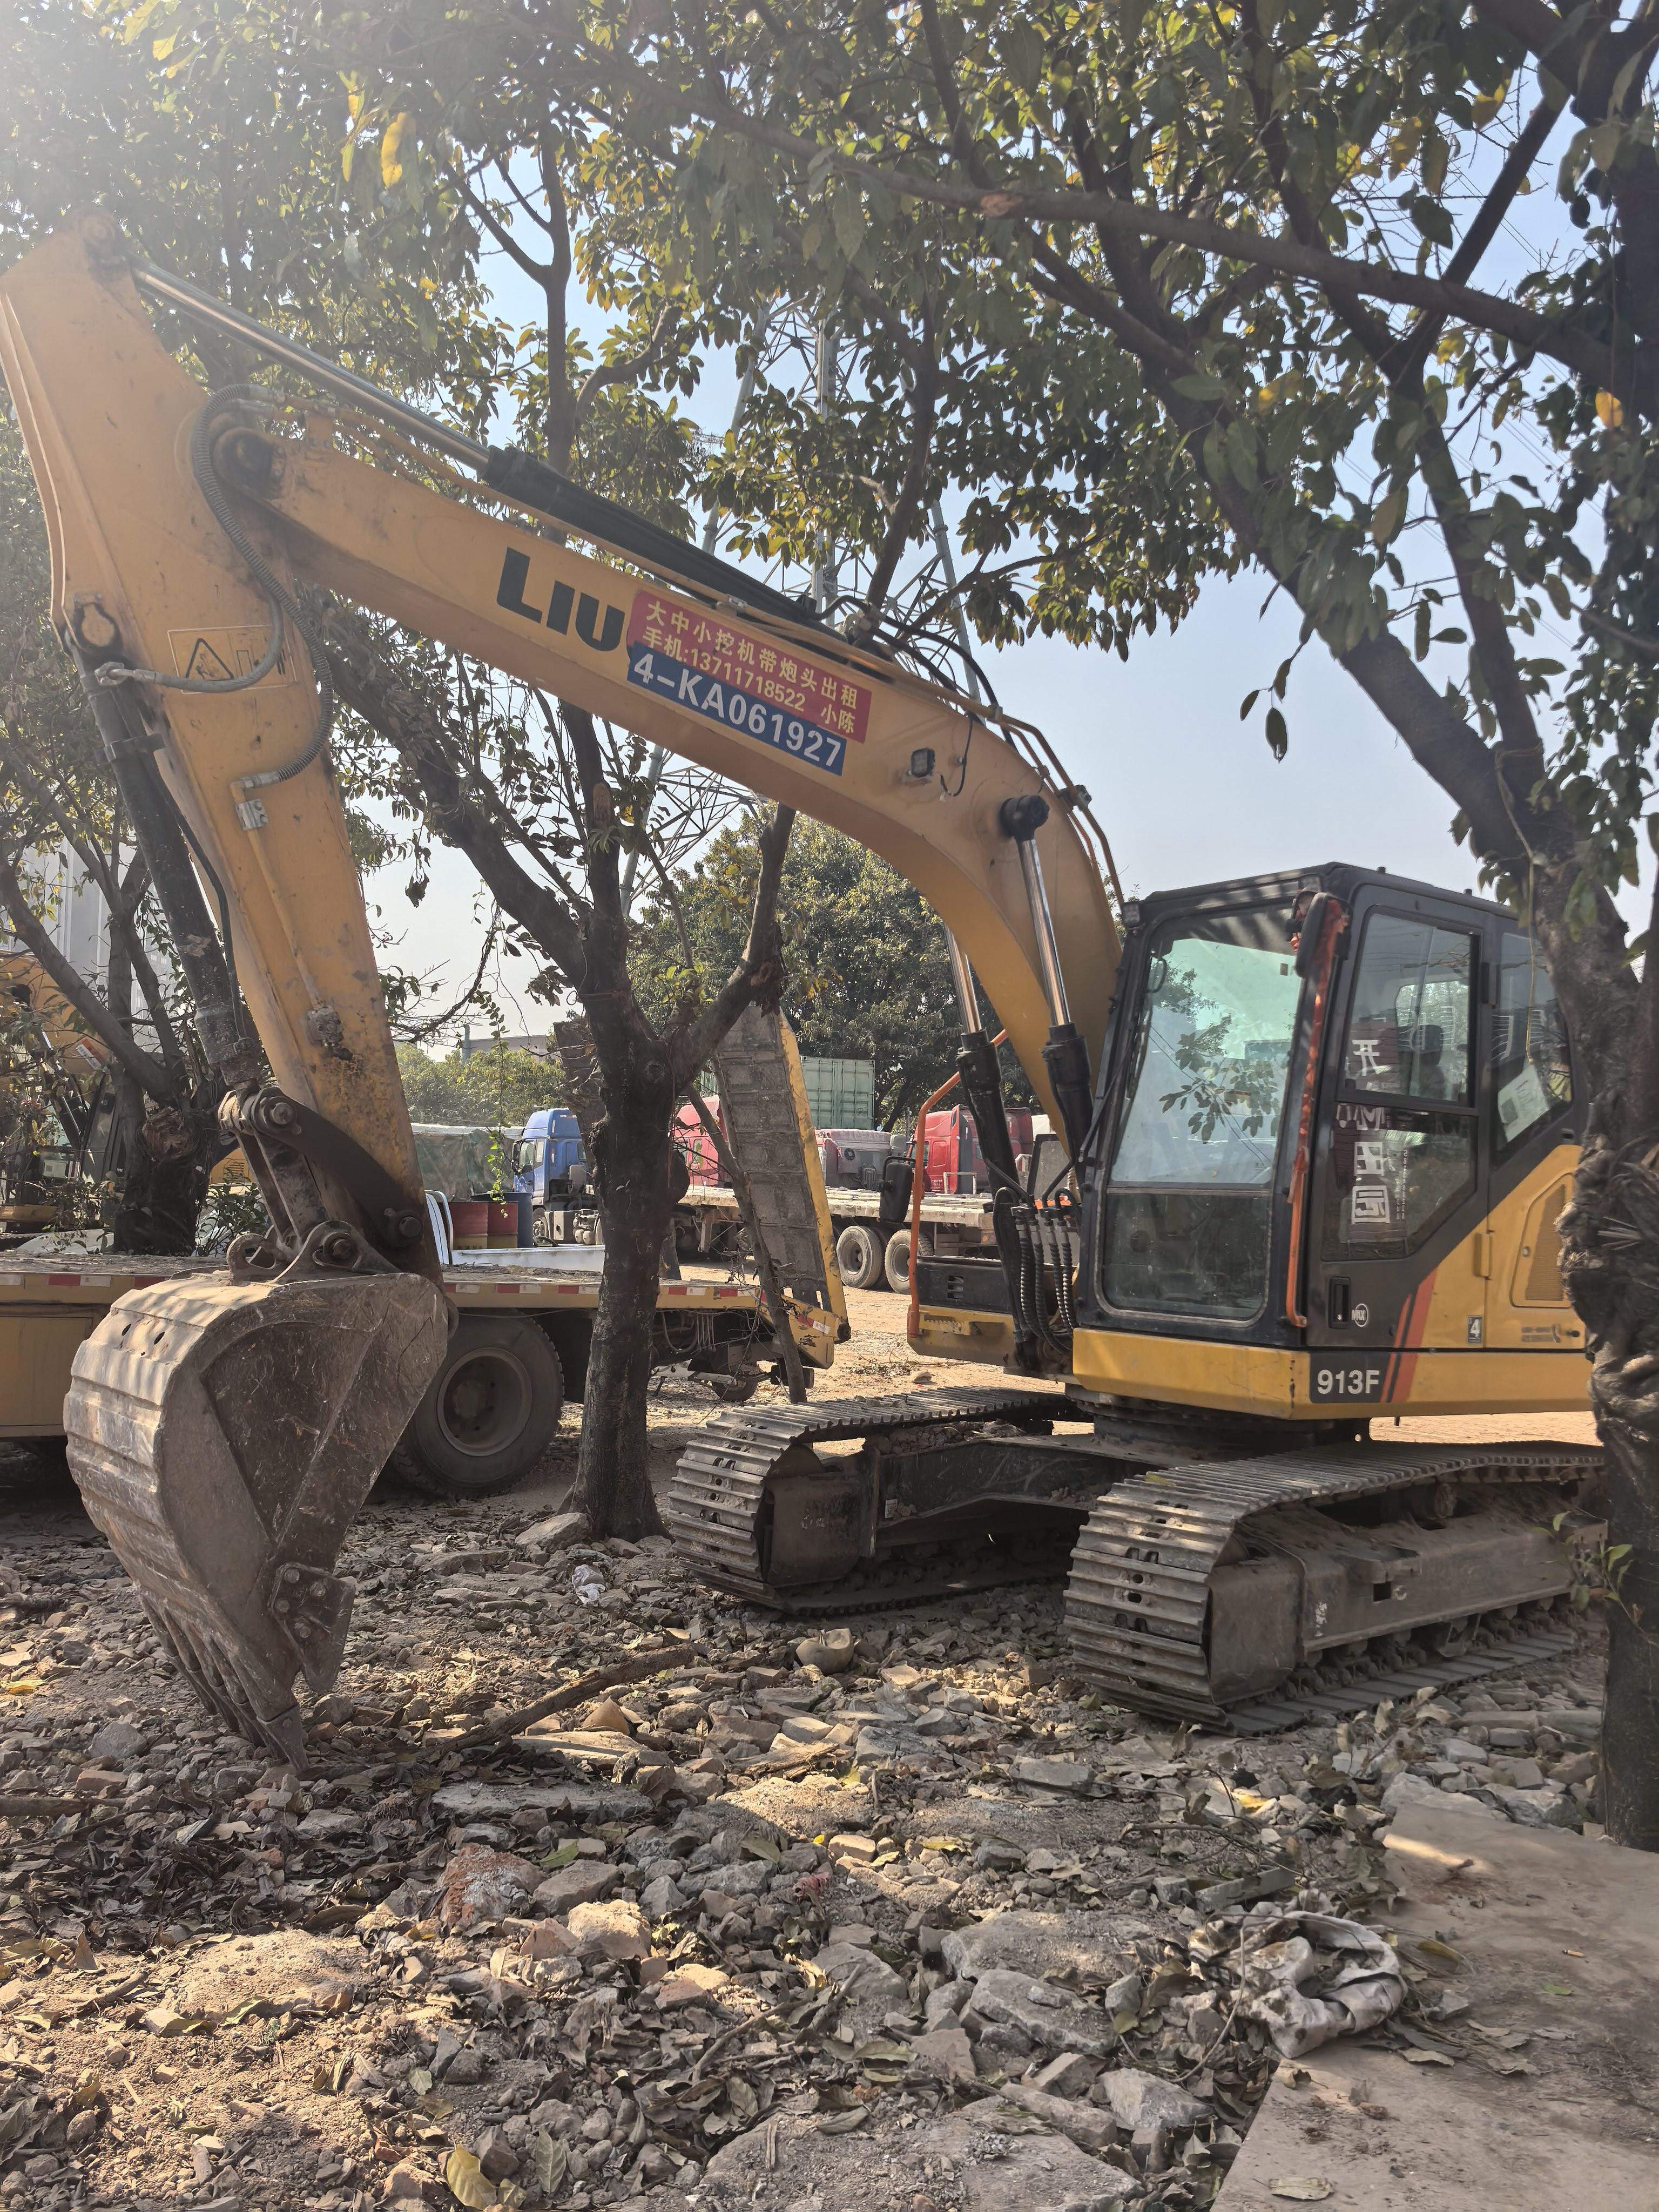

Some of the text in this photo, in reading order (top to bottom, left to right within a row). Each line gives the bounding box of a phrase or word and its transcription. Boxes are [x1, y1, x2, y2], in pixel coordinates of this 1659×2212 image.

[646, 601, 858, 709] 大中小挖机带炮头出租
[634, 653, 841, 766] 4-KA061927
[820, 704, 855, 733] 小陈
[1317, 1370, 1380, 1394] 913F
